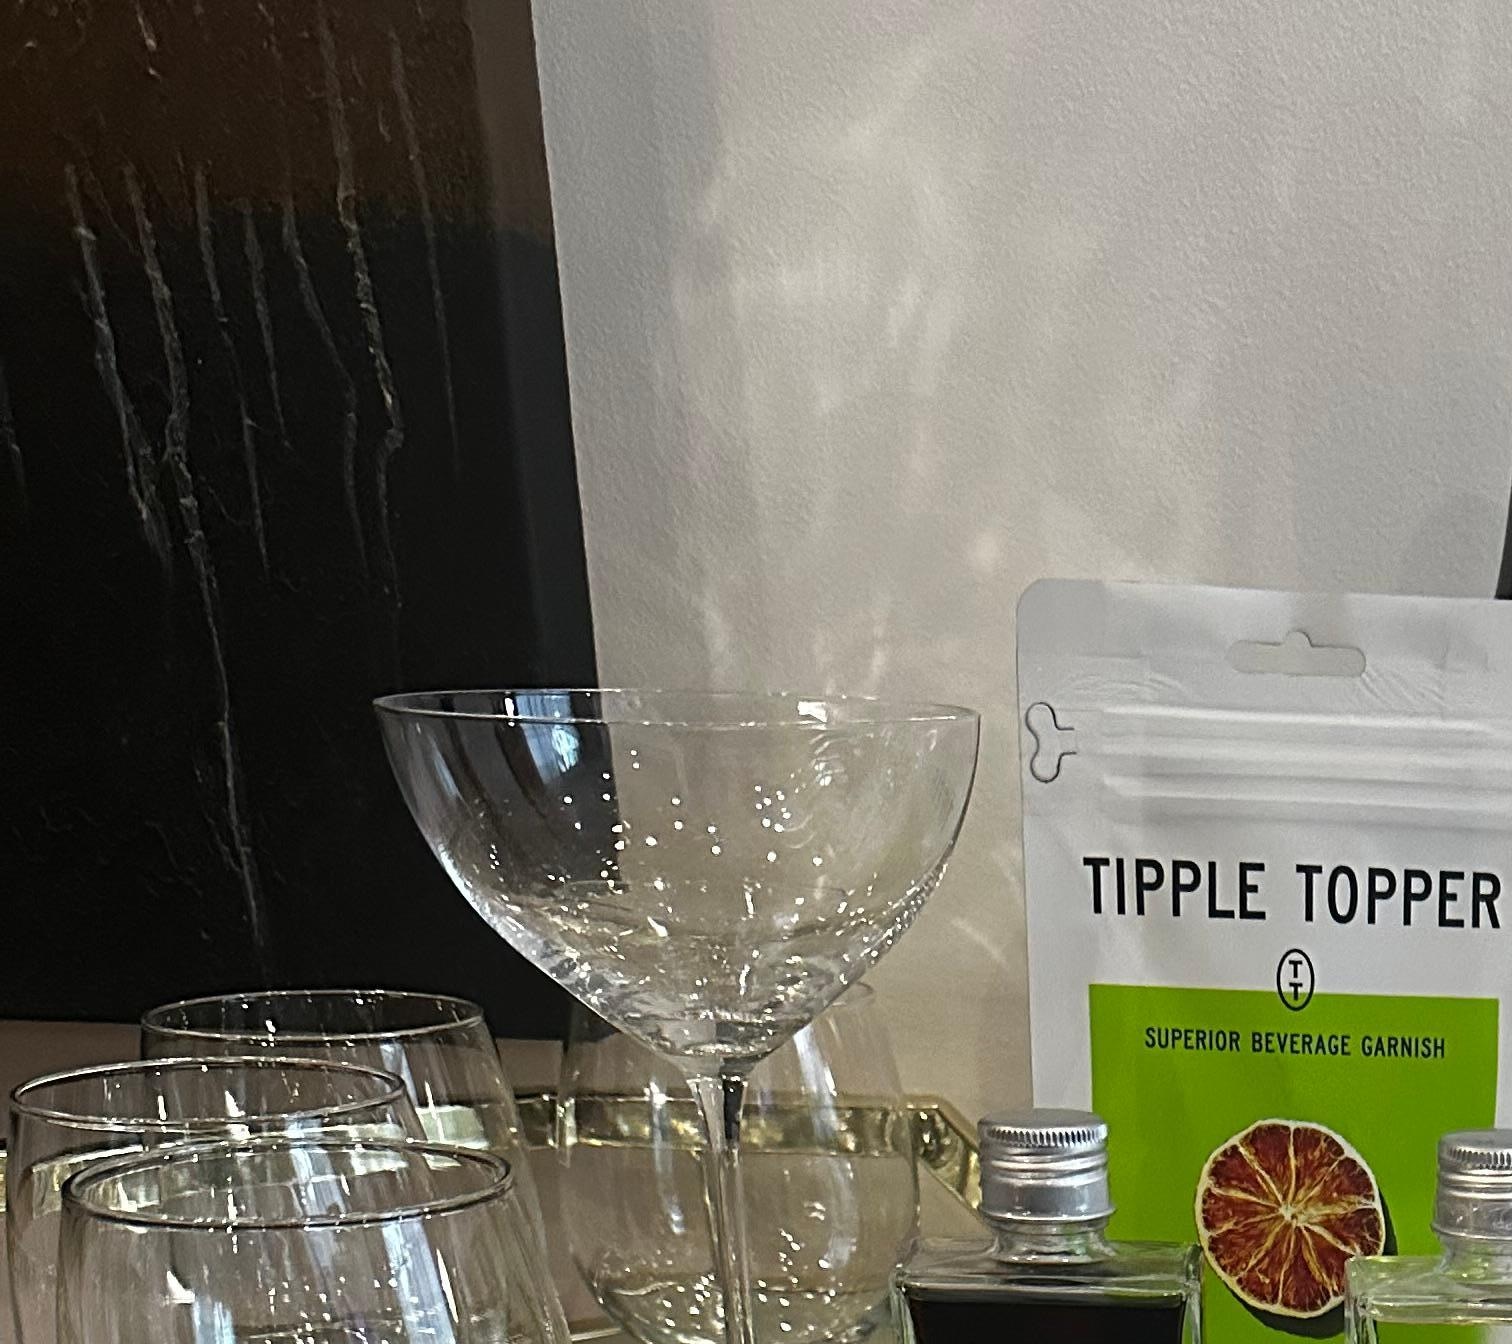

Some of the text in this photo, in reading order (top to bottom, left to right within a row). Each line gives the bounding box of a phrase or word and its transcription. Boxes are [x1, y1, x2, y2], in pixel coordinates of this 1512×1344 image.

[1083, 857, 1501, 929] TIPPLE TOPPER
[1145, 1027, 1445, 1059] SUPERIOR BEVERAGE GARNISH
